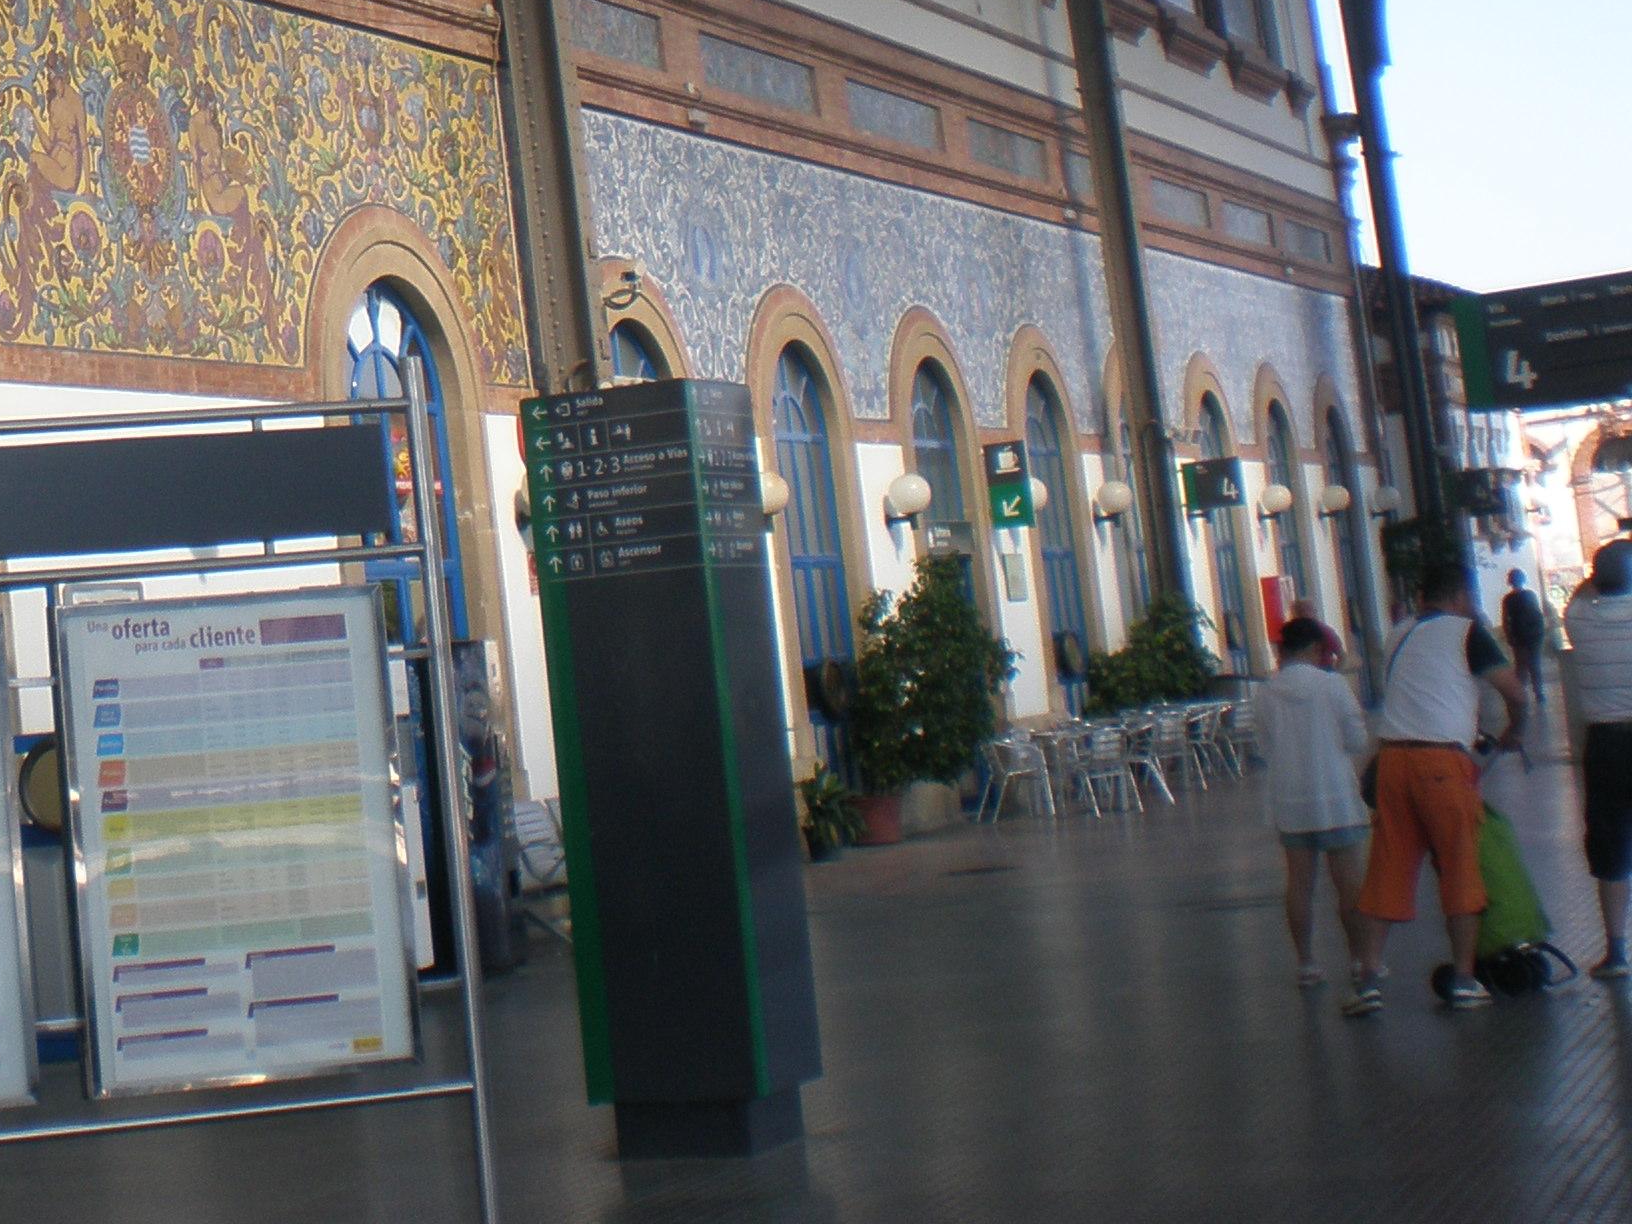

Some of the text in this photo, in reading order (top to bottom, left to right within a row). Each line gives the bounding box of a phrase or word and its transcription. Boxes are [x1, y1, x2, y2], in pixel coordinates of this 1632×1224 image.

[587, 489, 610, 500] Paso
[87, 617, 170, 640] Una oferta
[134, 625, 256, 655] para cada cliente
